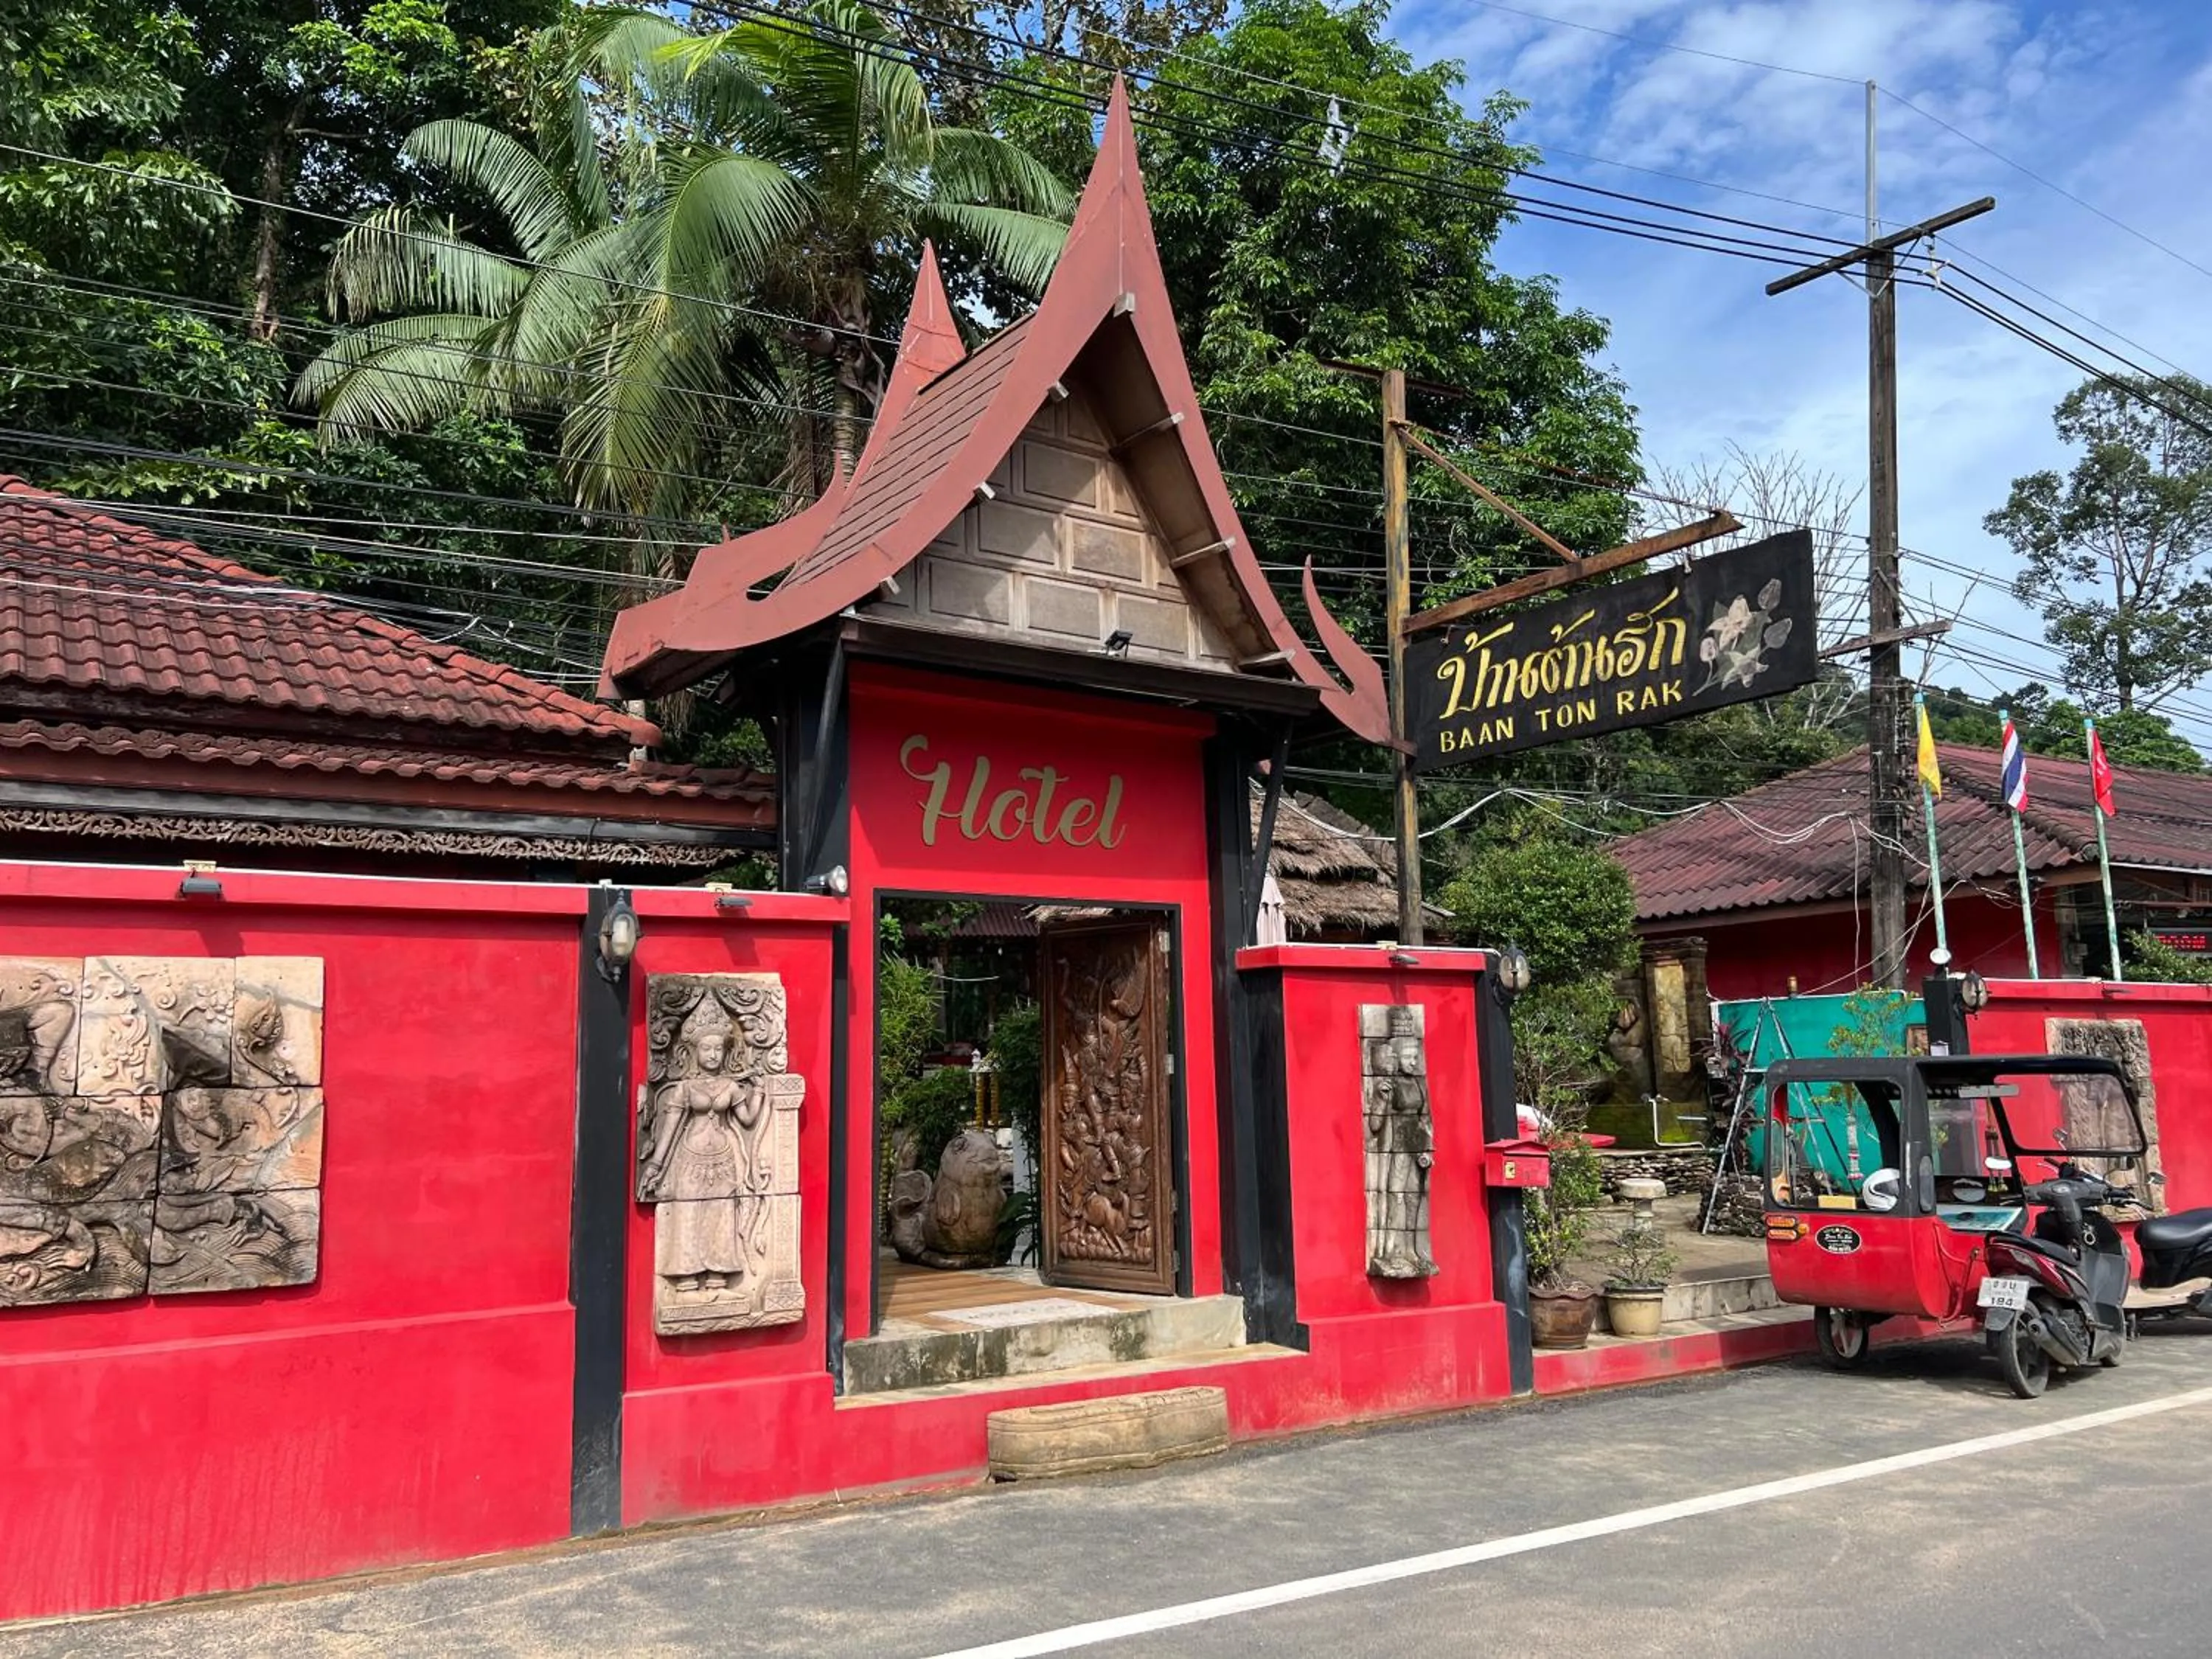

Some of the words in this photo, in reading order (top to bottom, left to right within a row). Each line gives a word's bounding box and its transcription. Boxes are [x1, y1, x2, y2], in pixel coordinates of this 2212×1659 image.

[1440, 717, 1514, 753] BAAN
[1534, 698, 1596, 731] TON
[1615, 679, 1683, 715] RAK
[901, 734, 1126, 849] Hotel
